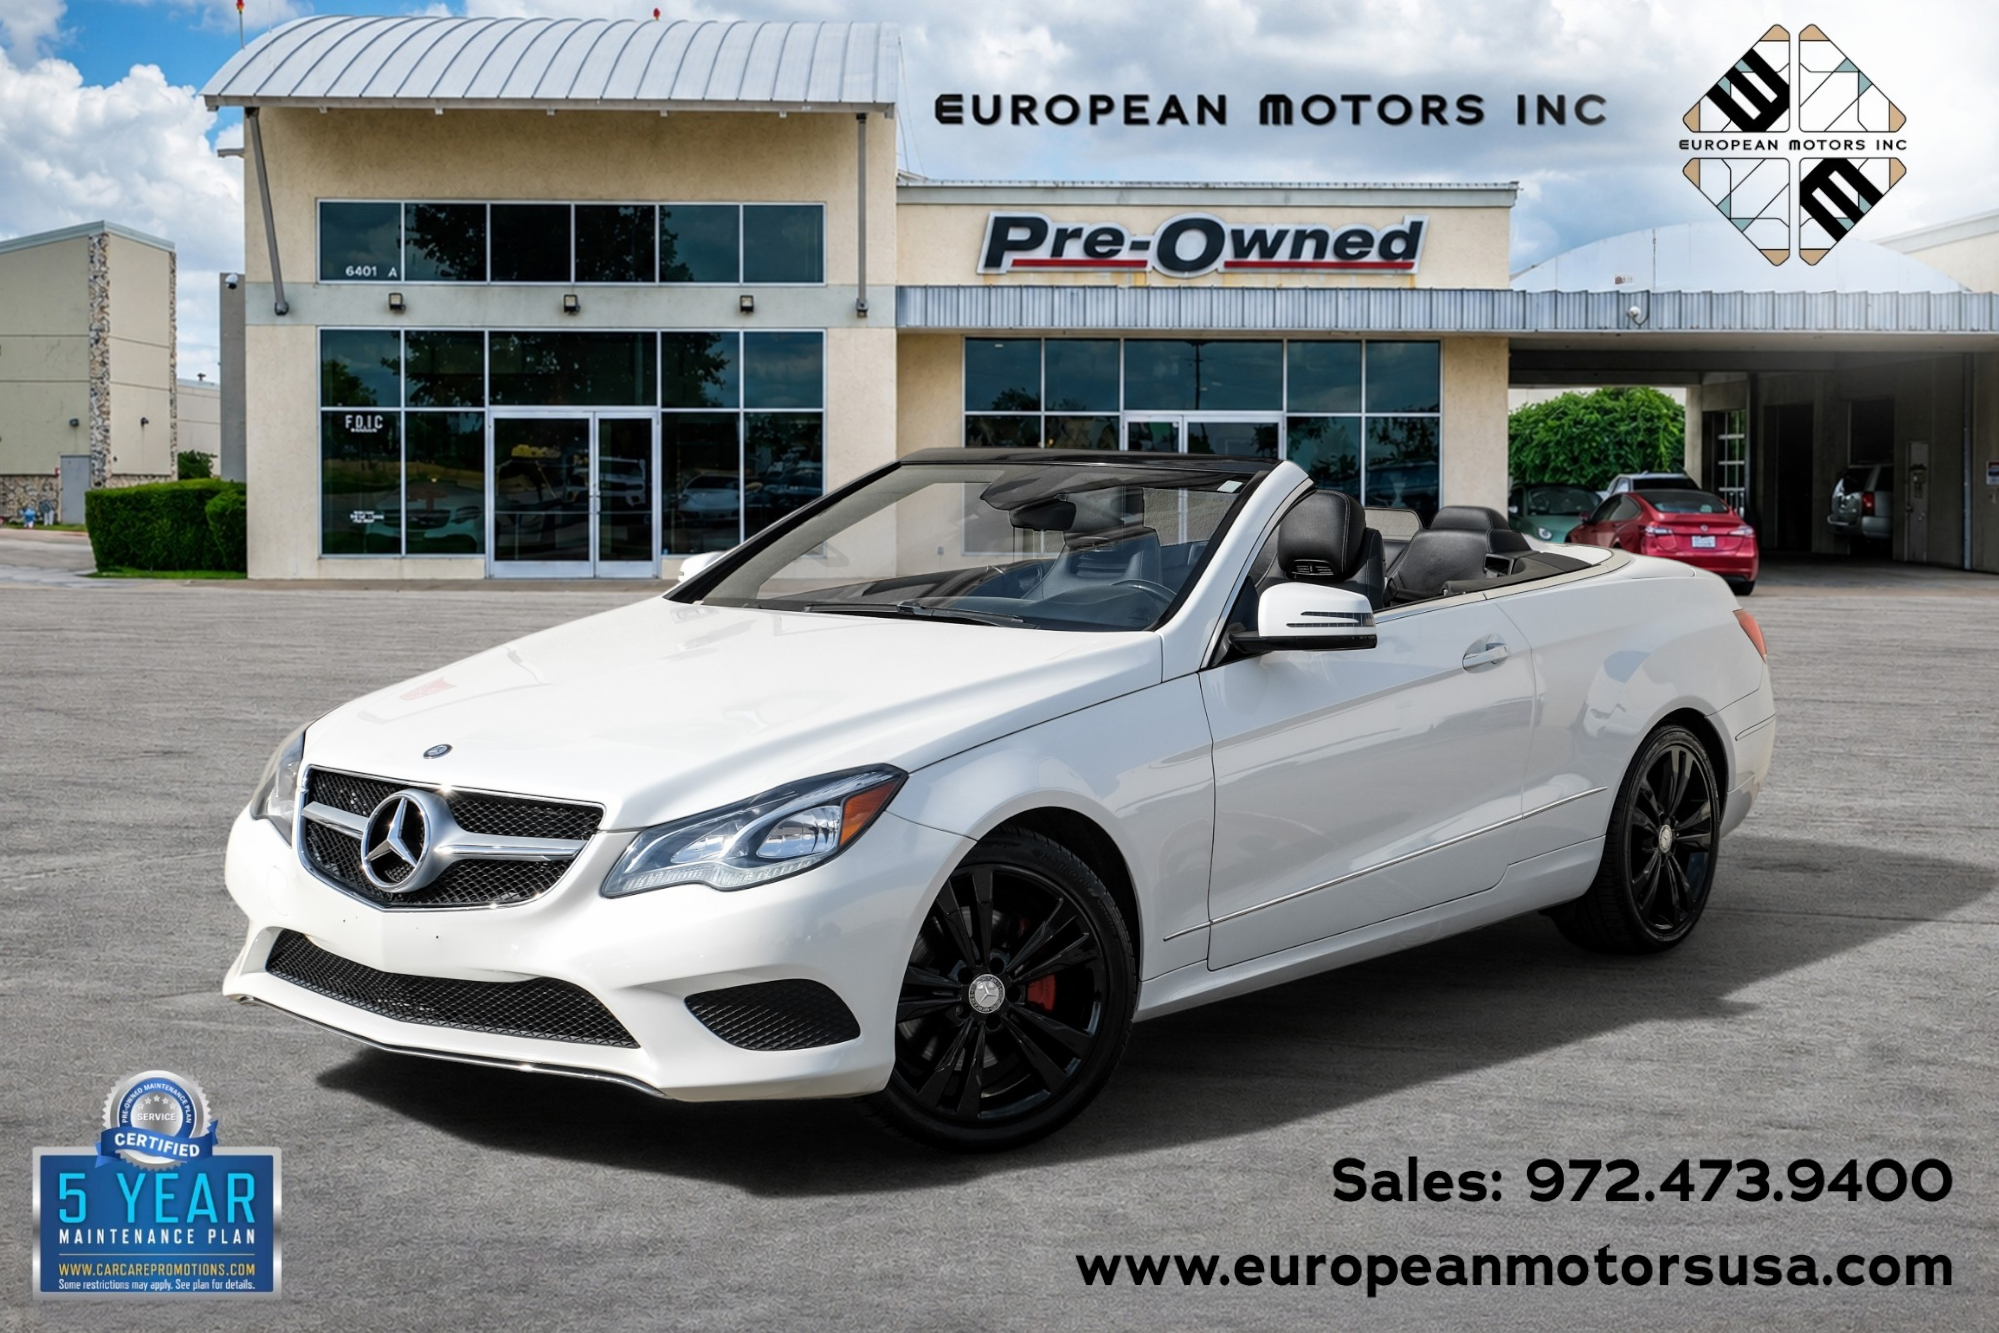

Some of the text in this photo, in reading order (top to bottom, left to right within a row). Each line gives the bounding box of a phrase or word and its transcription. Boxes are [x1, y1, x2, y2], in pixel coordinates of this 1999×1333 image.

[984, 216, 1424, 272] Pre-Owned
[345, 265, 398, 278] 6401 A
